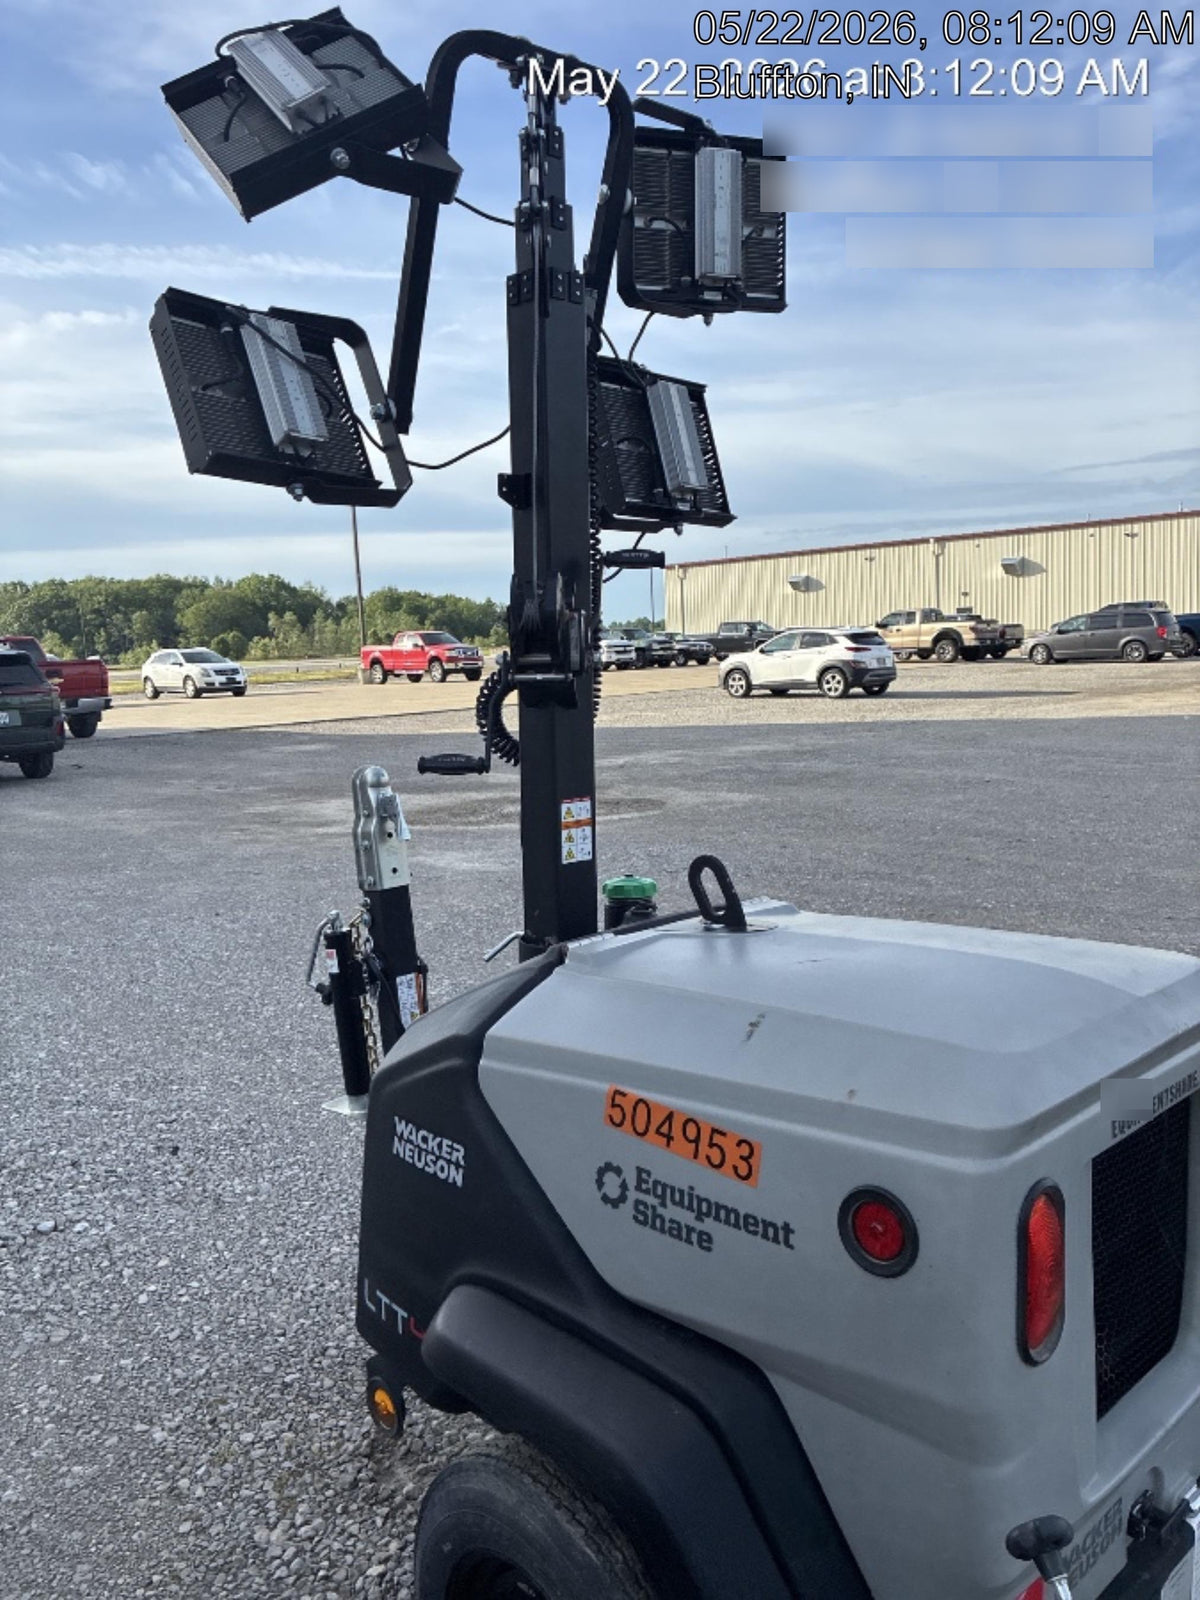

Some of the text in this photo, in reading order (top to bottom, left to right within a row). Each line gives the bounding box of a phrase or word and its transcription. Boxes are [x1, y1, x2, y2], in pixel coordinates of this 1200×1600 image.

[393, 1135, 464, 1188] NEUSON
[394, 1116, 465, 1166] WACKER
[608, 1089, 754, 1181] 504953
[632, 1198, 714, 1252] Share
[634, 1165, 795, 1250] Equipment
[1068, 1516, 1123, 1589] EUSON
